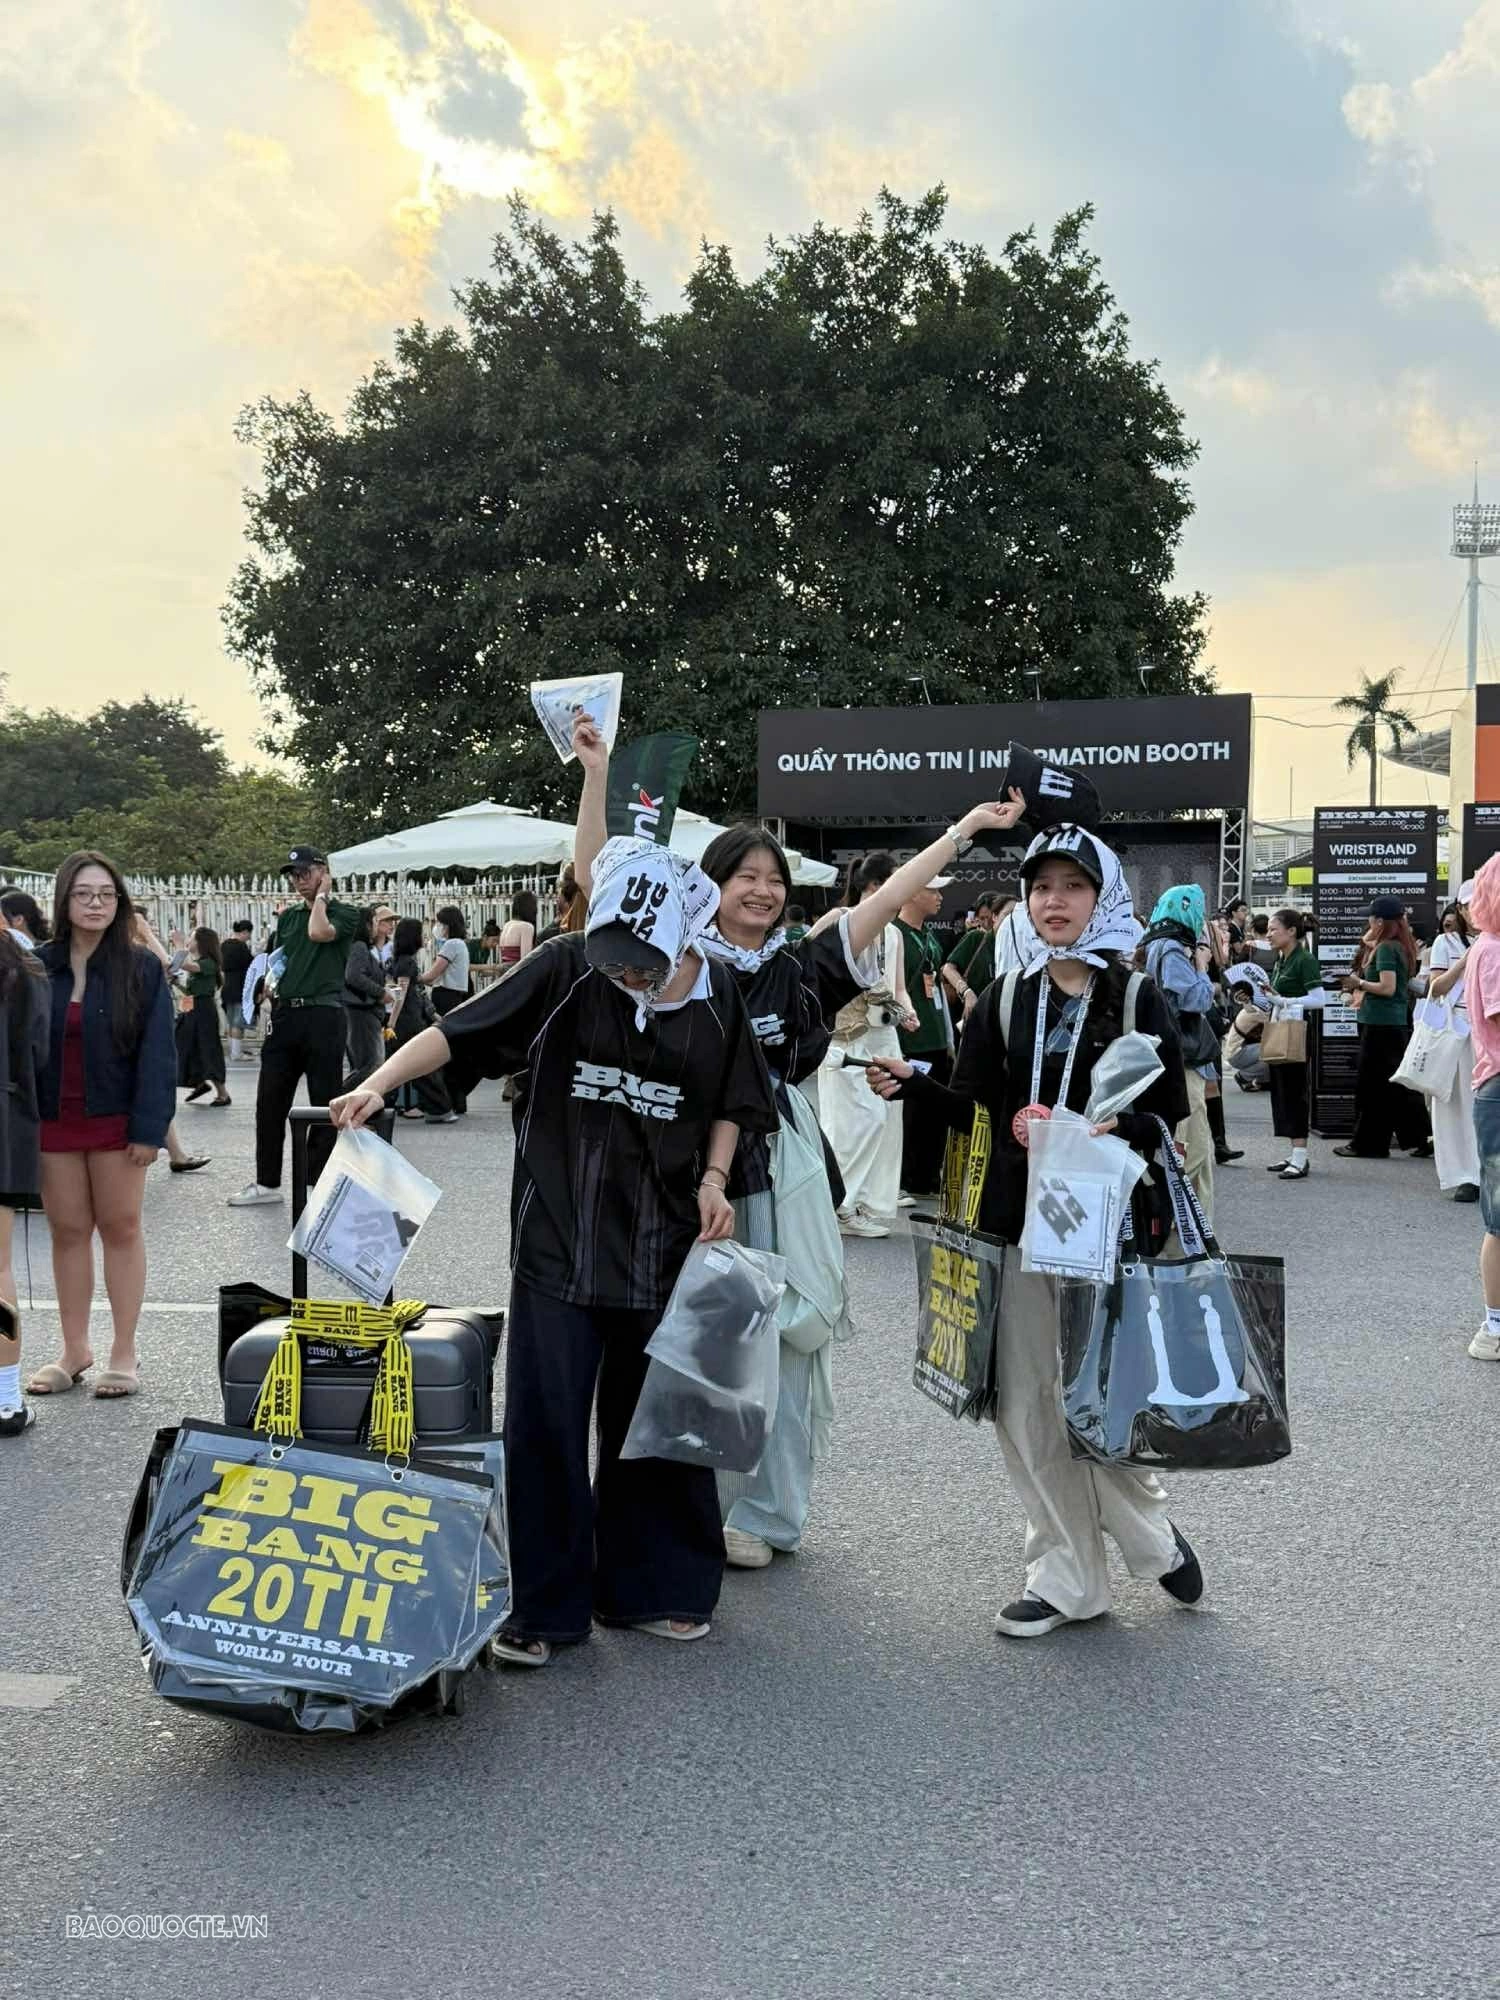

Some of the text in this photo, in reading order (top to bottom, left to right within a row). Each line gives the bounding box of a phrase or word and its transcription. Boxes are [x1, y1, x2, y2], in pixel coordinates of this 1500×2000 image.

[777, 746, 838, 772] QUẦY
[843, 747, 921, 772] THÔNG
[926, 751, 963, 771] TIN
[980, 744, 1141, 769] INFRMATION
[1146, 740, 1231, 763] BOOTH
[1319, 810, 1427, 820] BIGBANG
[1328, 843, 1417, 856] WRISTBAND
[1336, 857, 1409, 866] EXCHANGE GUIDE
[570, 1083, 679, 1121] BANG
[573, 1060, 685, 1106] BIG
[930, 1243, 981, 1299] BIG
[322, 1325, 361, 1337] BANG
[275, 1378, 285, 1417] BIG
[201, 1460, 440, 1546] BIG
[190, 1514, 428, 1585] BANG
[206, 1557, 394, 1643] 20TH
[160, 1609, 415, 1669] ANNIVERSARY
[214, 1639, 353, 1677] WORLD TOUR
